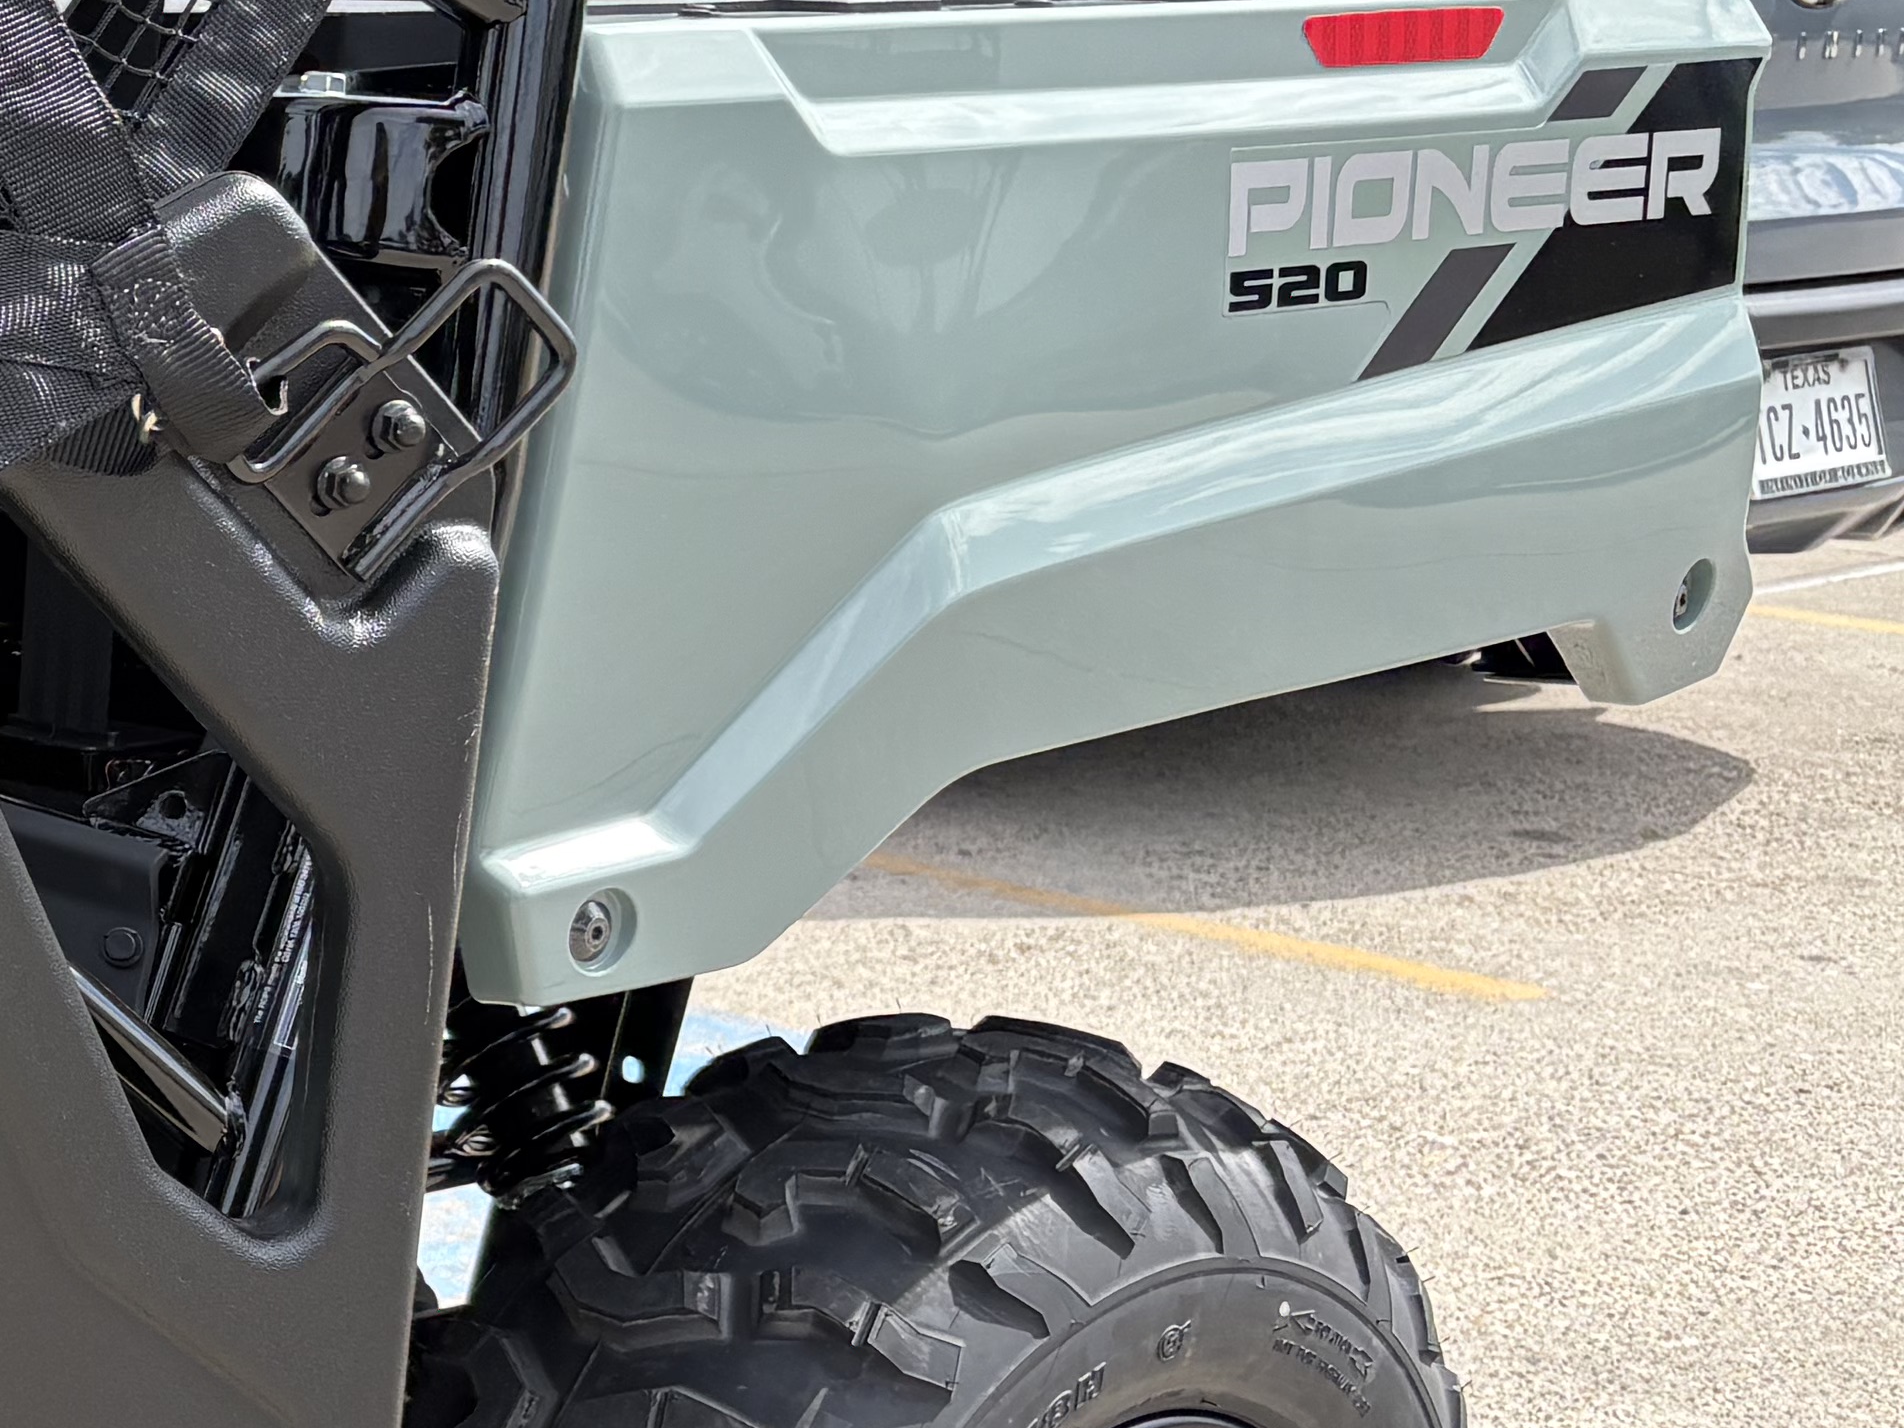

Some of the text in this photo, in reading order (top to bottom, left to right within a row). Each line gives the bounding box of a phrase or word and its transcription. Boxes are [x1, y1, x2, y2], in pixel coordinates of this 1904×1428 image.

[1227, 127, 1722, 257] PIONEER
[1228, 260, 1368, 312] 520
[1782, 364, 1831, 391] TEXAS
